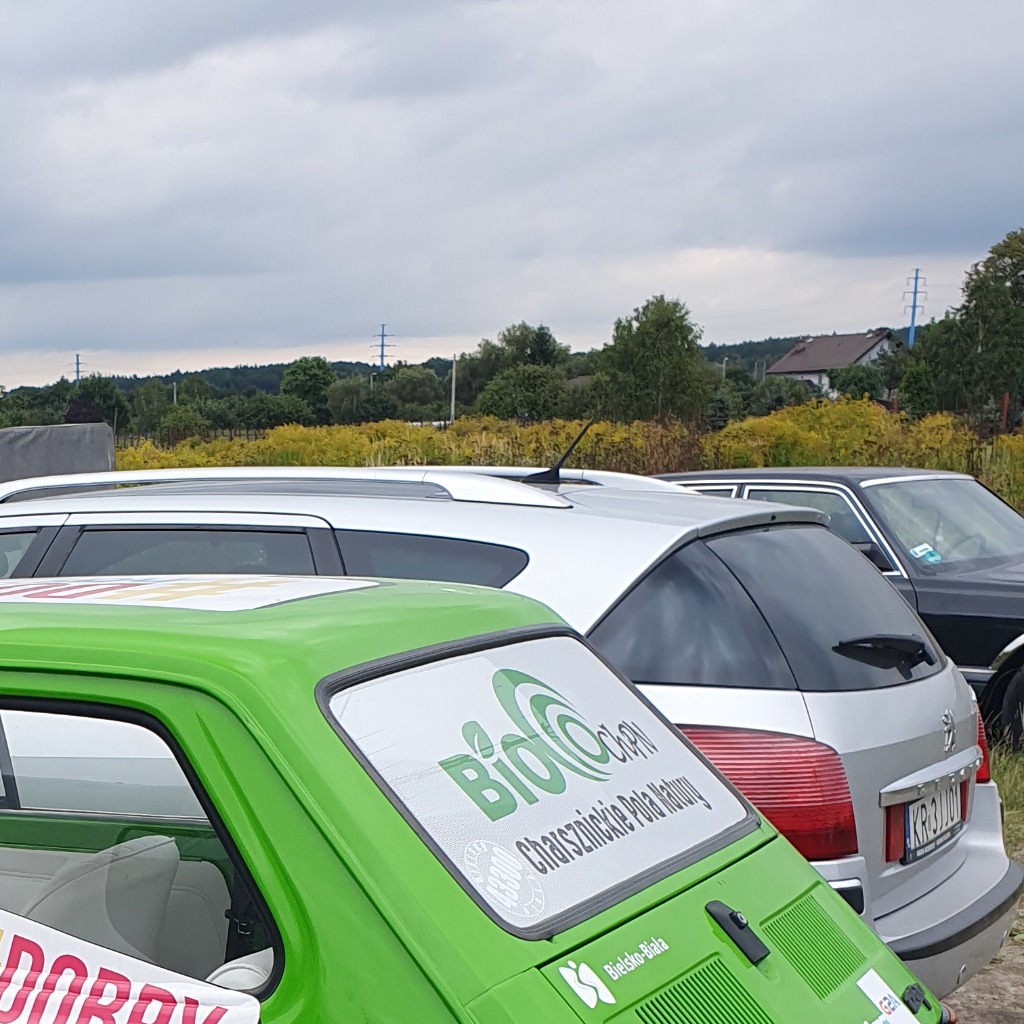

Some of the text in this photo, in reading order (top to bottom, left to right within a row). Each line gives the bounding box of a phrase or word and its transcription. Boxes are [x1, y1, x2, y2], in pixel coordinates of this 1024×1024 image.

[515, 775, 713, 875] Charsznickie Pola Natury
[912, 803, 928, 848] KR
